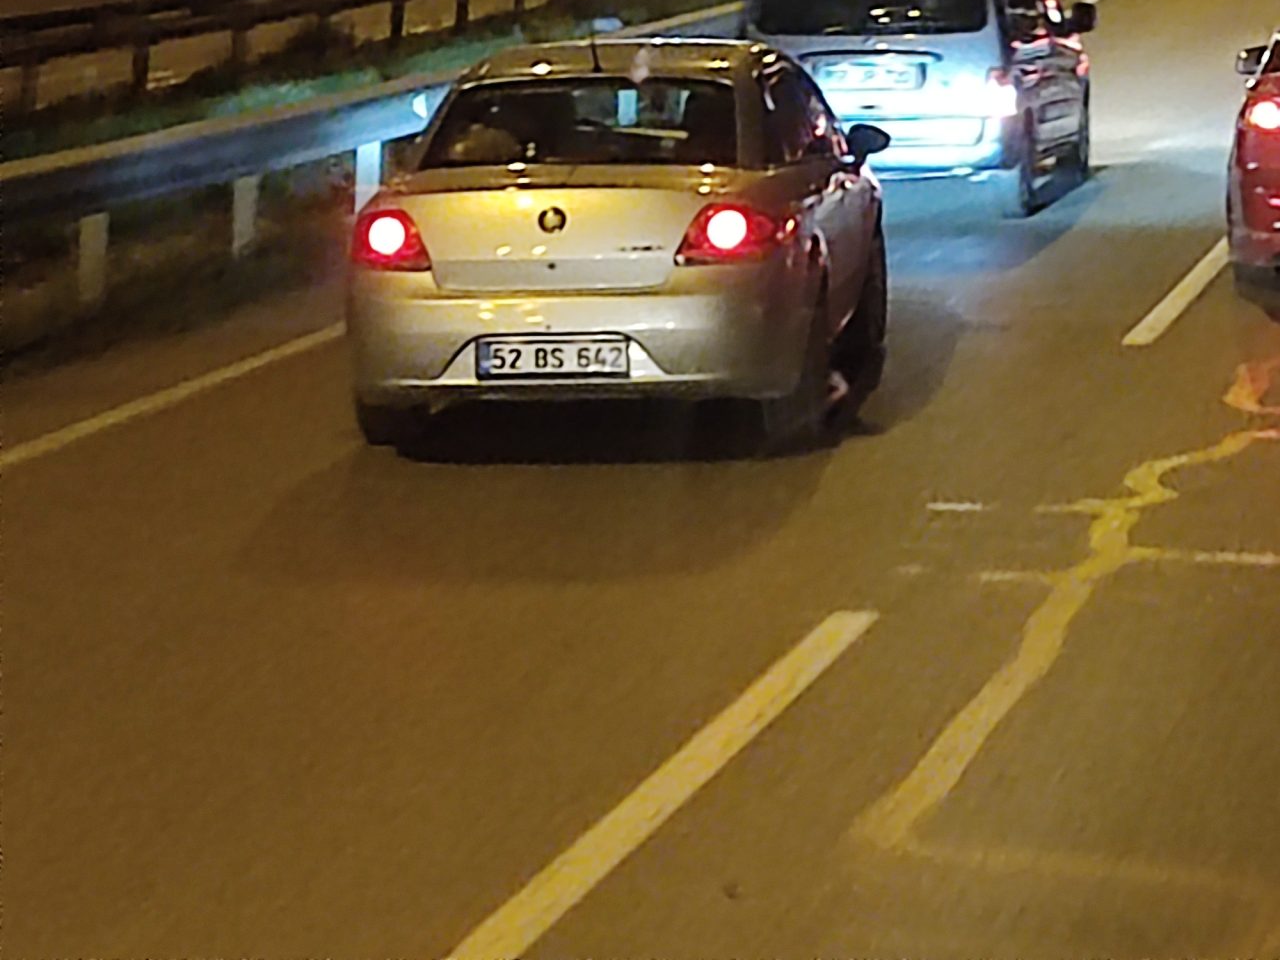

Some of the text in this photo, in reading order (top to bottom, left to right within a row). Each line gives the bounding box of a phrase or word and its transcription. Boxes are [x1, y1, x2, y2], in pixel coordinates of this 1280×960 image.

[492, 347, 623, 369] 52 BS 642
